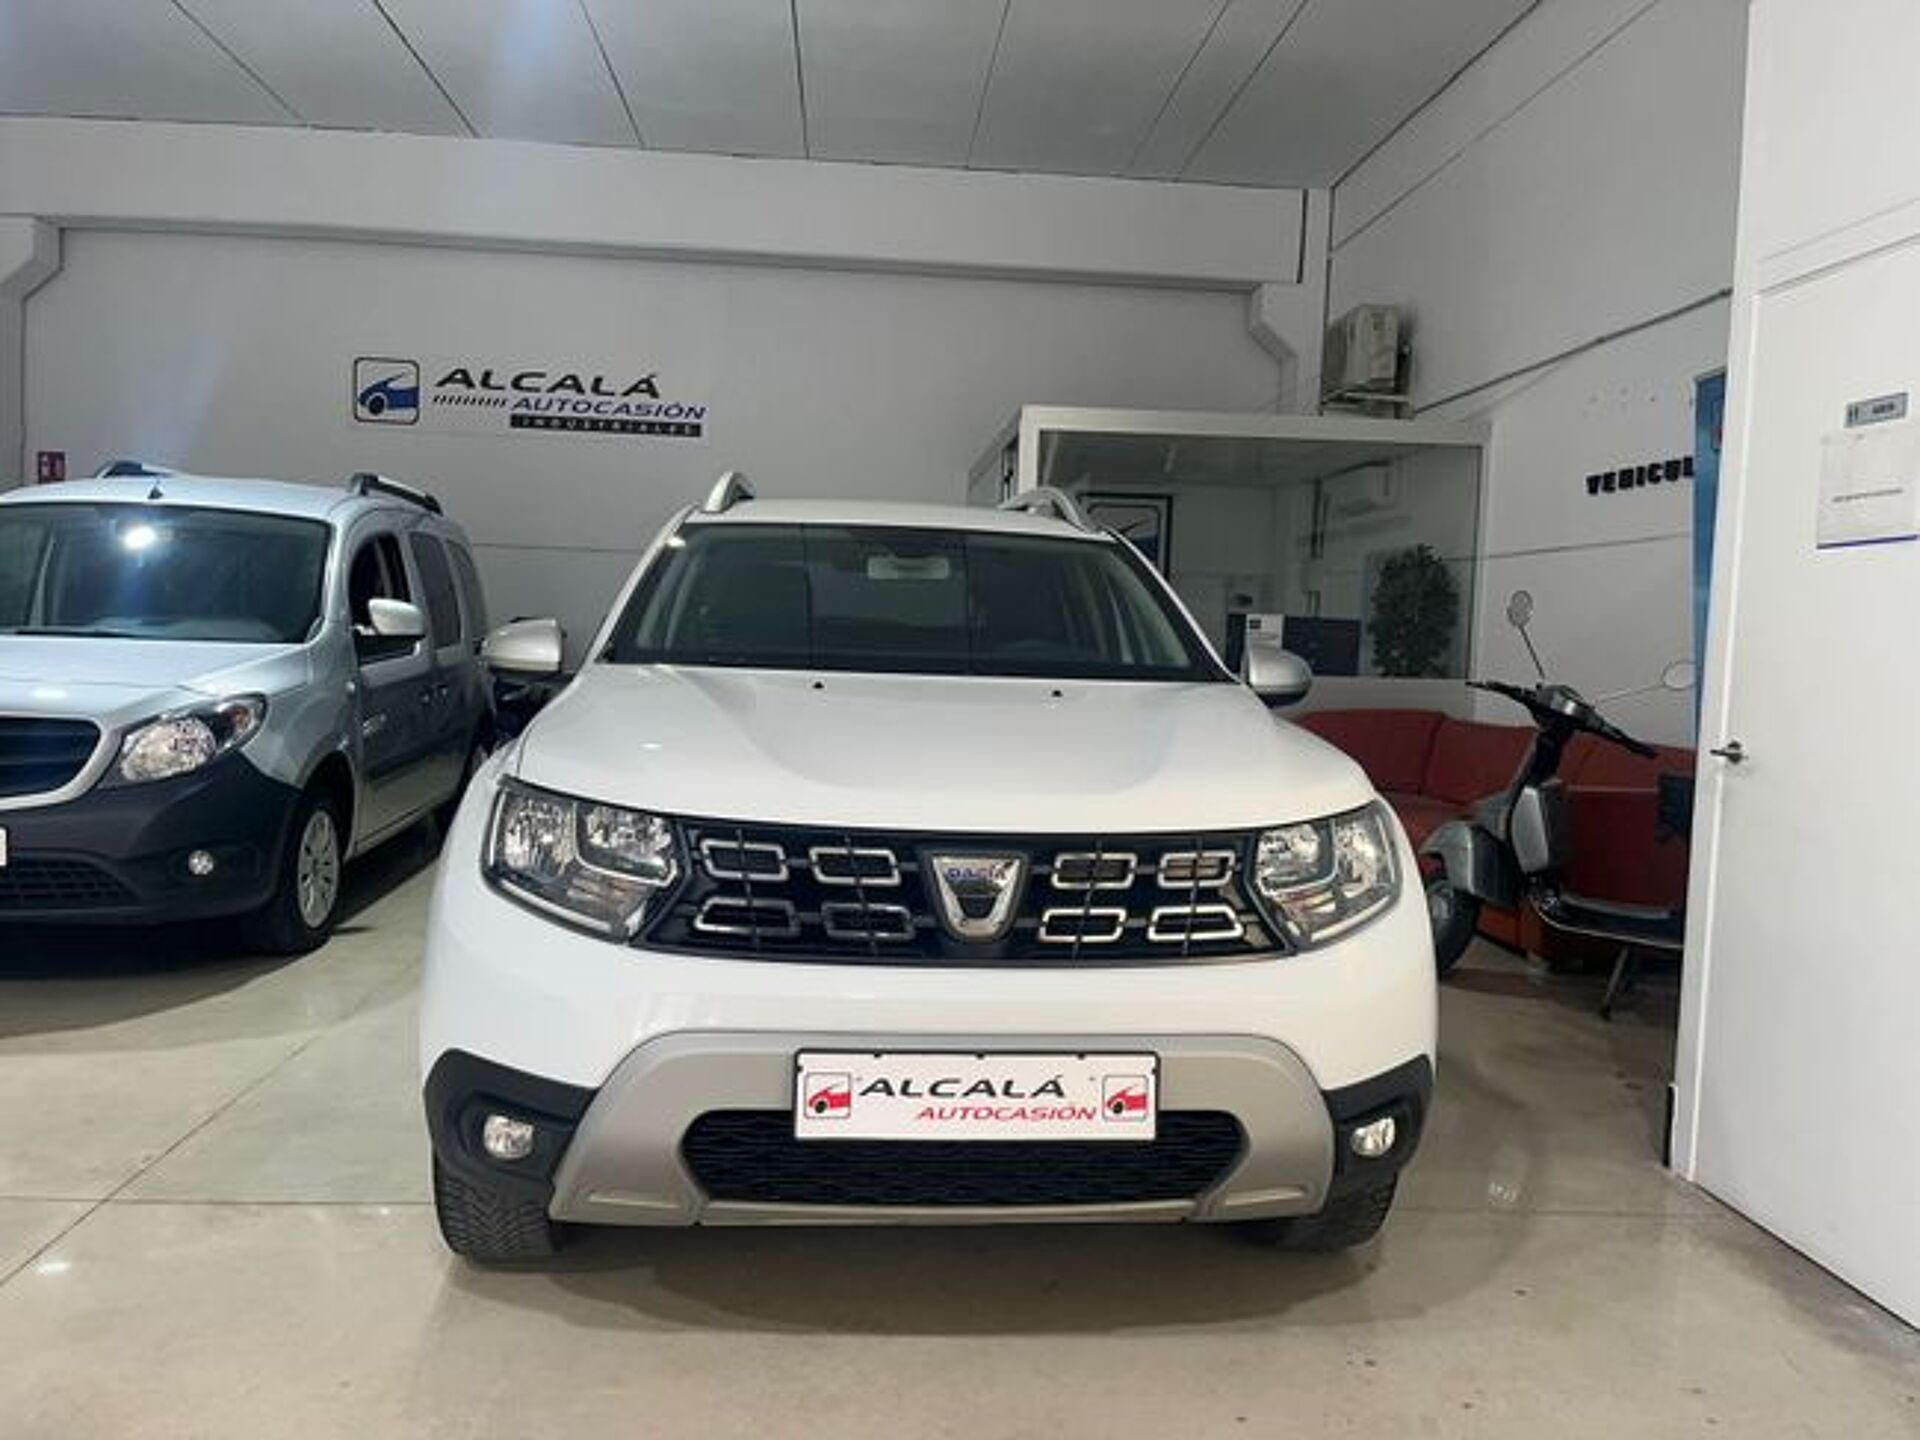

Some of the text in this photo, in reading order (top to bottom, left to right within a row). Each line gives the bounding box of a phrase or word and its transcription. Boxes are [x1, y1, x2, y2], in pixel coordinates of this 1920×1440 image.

[436, 367, 661, 398] ALCALÁ
[512, 396, 705, 420] AUTOCASIÓN
[859, 1075, 1066, 1098] ALCALÁ
